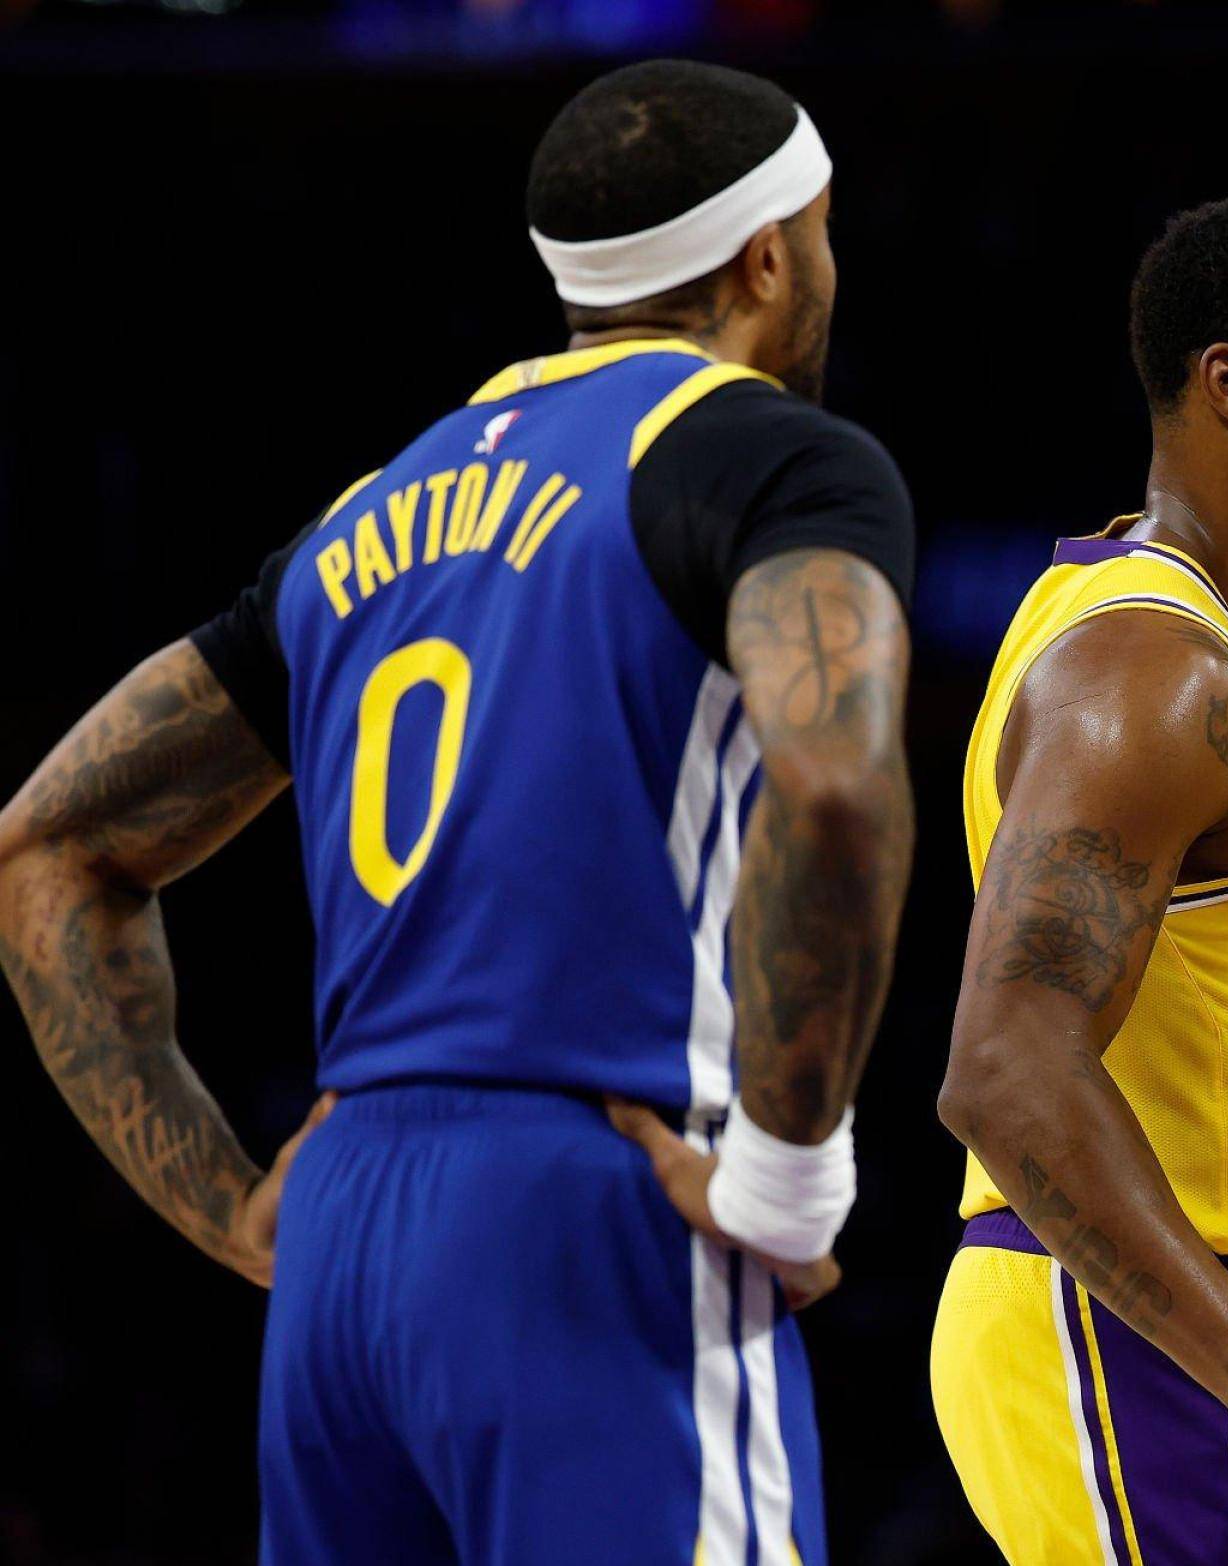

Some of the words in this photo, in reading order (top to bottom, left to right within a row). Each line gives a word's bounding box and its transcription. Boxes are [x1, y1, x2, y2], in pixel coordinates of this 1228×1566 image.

[315, 459, 529, 620] PAYTON
[503, 471, 583, 574] II
[348, 636, 472, 908] 0
